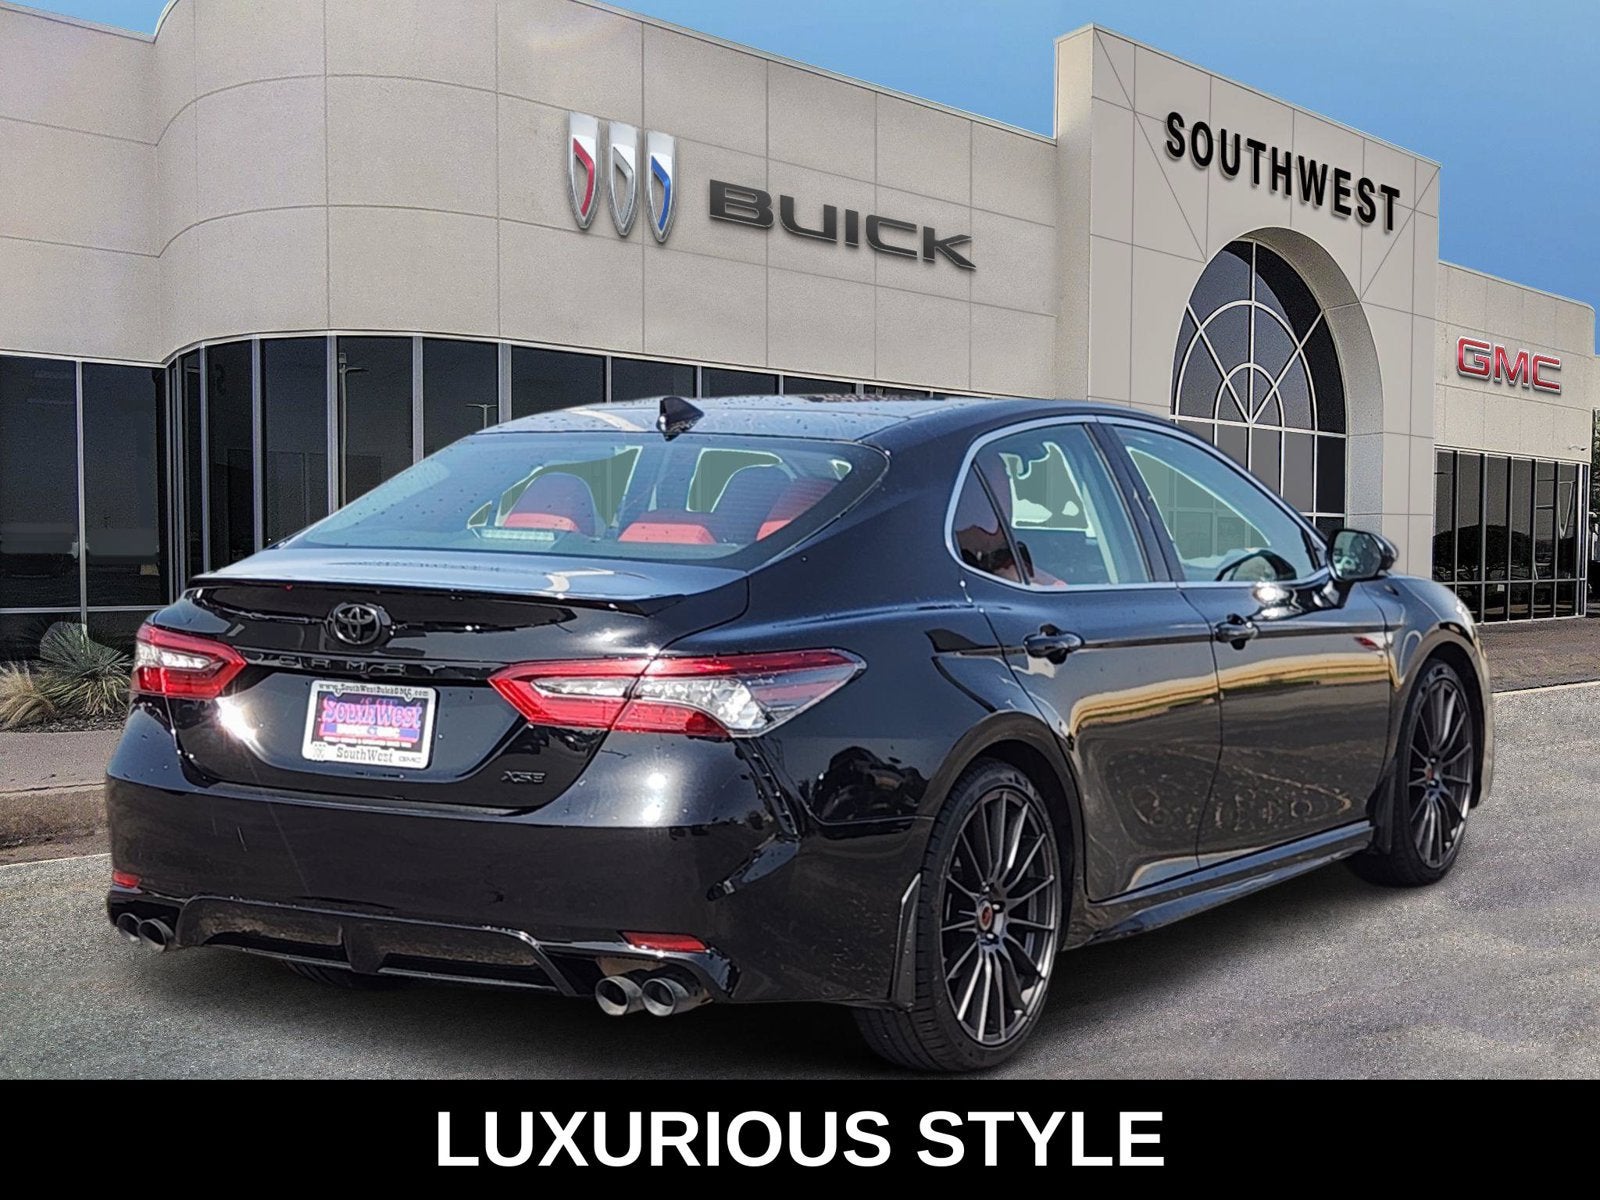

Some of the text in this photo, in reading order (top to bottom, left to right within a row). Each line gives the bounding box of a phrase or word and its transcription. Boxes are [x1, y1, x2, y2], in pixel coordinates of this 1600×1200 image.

[1166, 111, 1401, 231] SOUTHWEST
[709, 179, 977, 270] BUICK
[1457, 334, 1561, 394] GMC
[278, 655, 446, 676] CAMRY
